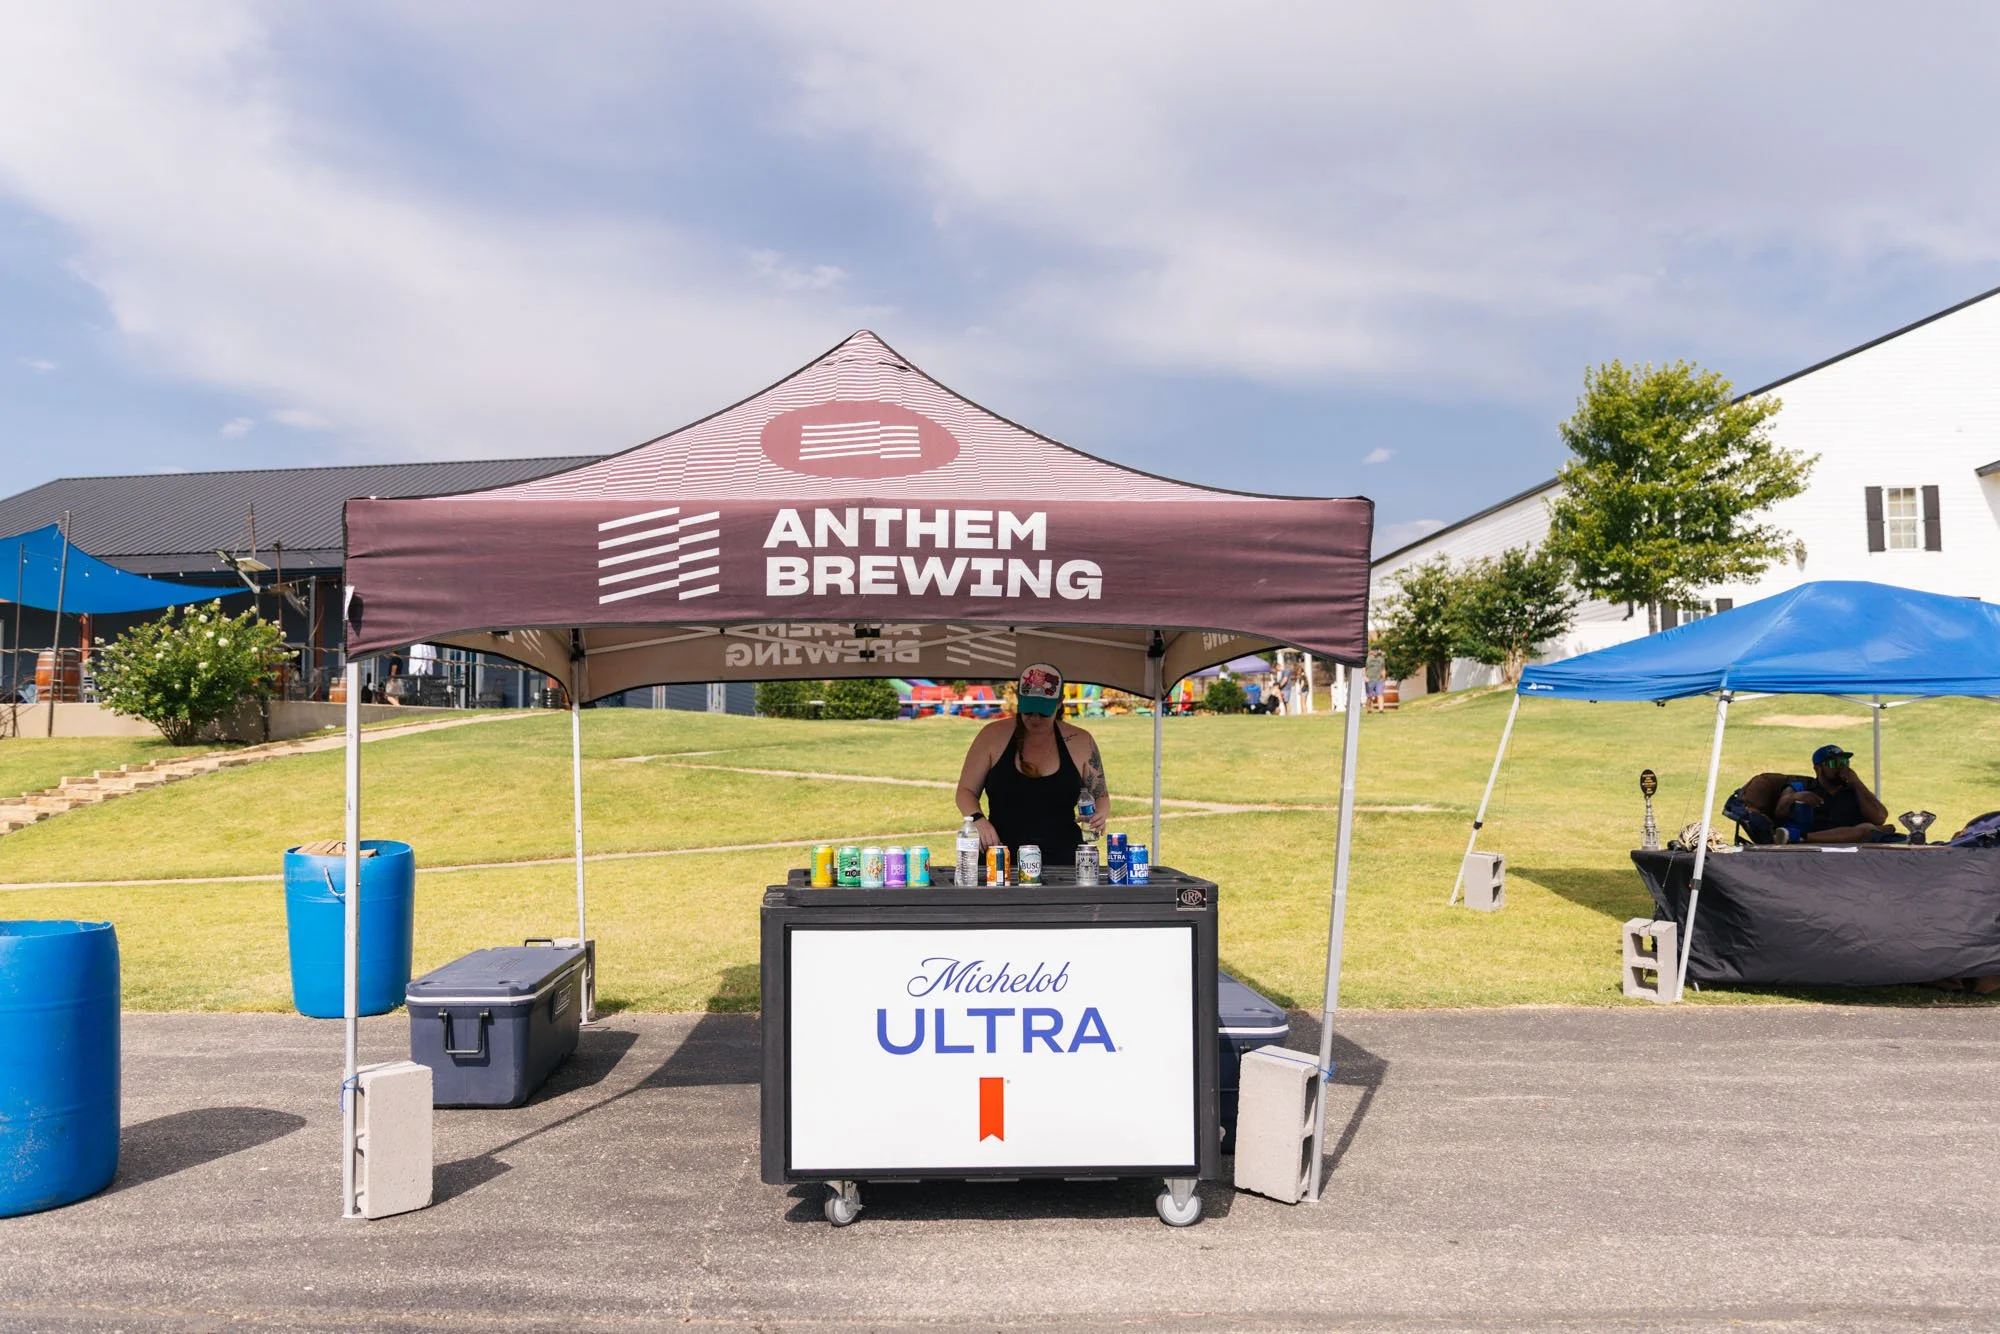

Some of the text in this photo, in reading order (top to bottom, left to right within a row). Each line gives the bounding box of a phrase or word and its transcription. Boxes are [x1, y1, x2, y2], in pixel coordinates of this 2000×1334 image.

[763, 508, 1047, 550] ANTHEM
[766, 556, 1103, 600] BREWING
[1021, 862, 1040, 870] BUSC
[1130, 870, 1148, 878] LIGH
[907, 957, 1070, 997] Michelob
[877, 1007, 1117, 1055] ULTRA
